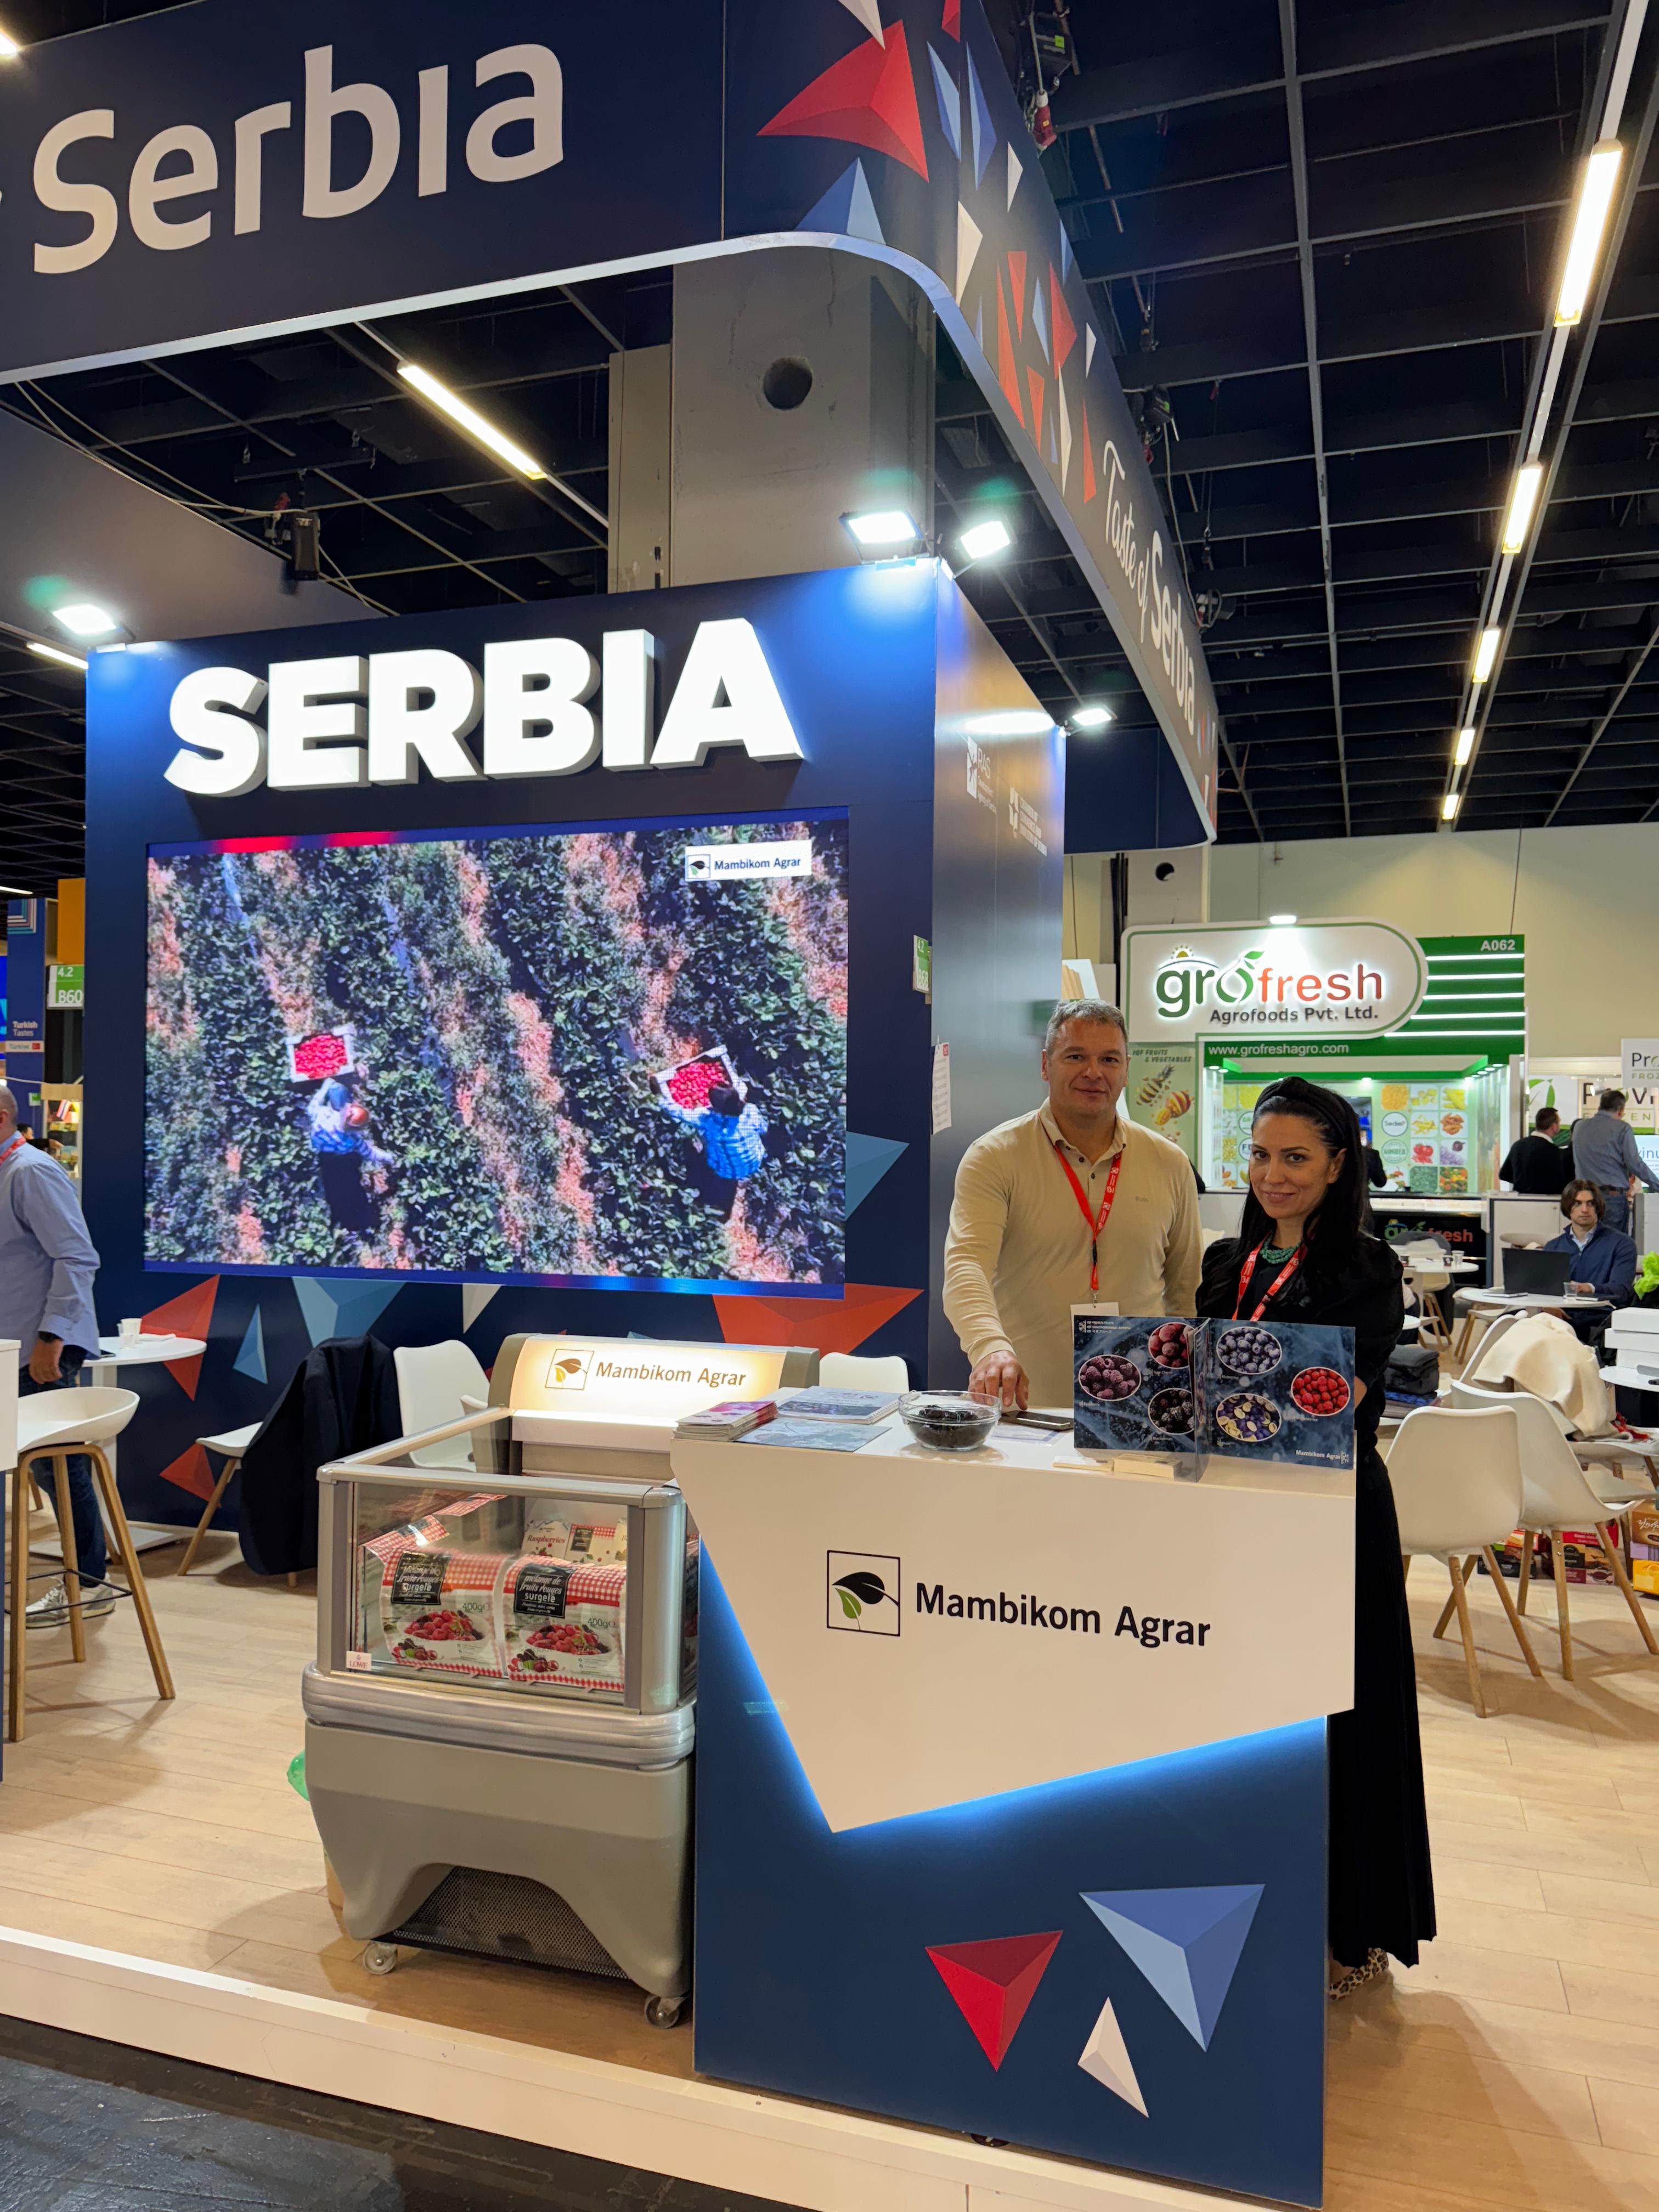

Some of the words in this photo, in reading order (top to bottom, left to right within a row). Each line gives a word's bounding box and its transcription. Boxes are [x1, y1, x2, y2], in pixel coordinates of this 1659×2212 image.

[33, 43, 564, 274] Serbia
[1103, 441, 1137, 589] Taste
[1137, 548, 1149, 643] of
[1152, 531, 1195, 736] Serbia
[163, 617, 804, 797] SERBIA
[978, 747, 991, 779] RAS
[715, 859, 770, 870] Mambikom
[774, 858, 801, 870] Agrar
[1481, 939, 1515, 951] A062
[58, 967, 74, 977] 4.2
[1156, 964, 1381, 1018] grofresh
[1210, 1008, 1298, 1024] Agrofoods
[1305, 1007, 1338, 1020] Pvt.
[1345, 1006, 1378, 1019] Ltd.
[1209, 1045, 1349, 1057] www.grofreshagro.com
[596, 1362, 691, 1383] Mambikom
[697, 1368, 746, 1388] Agrar
[1296, 1449, 1325, 1458] Mambikom
[527, 1534, 566, 1544] Raspberries
[525, 1592, 556, 1603] surgelé
[916, 1582, 1101, 1634] Mambikom
[1114, 1606, 1211, 1649] Agrar
